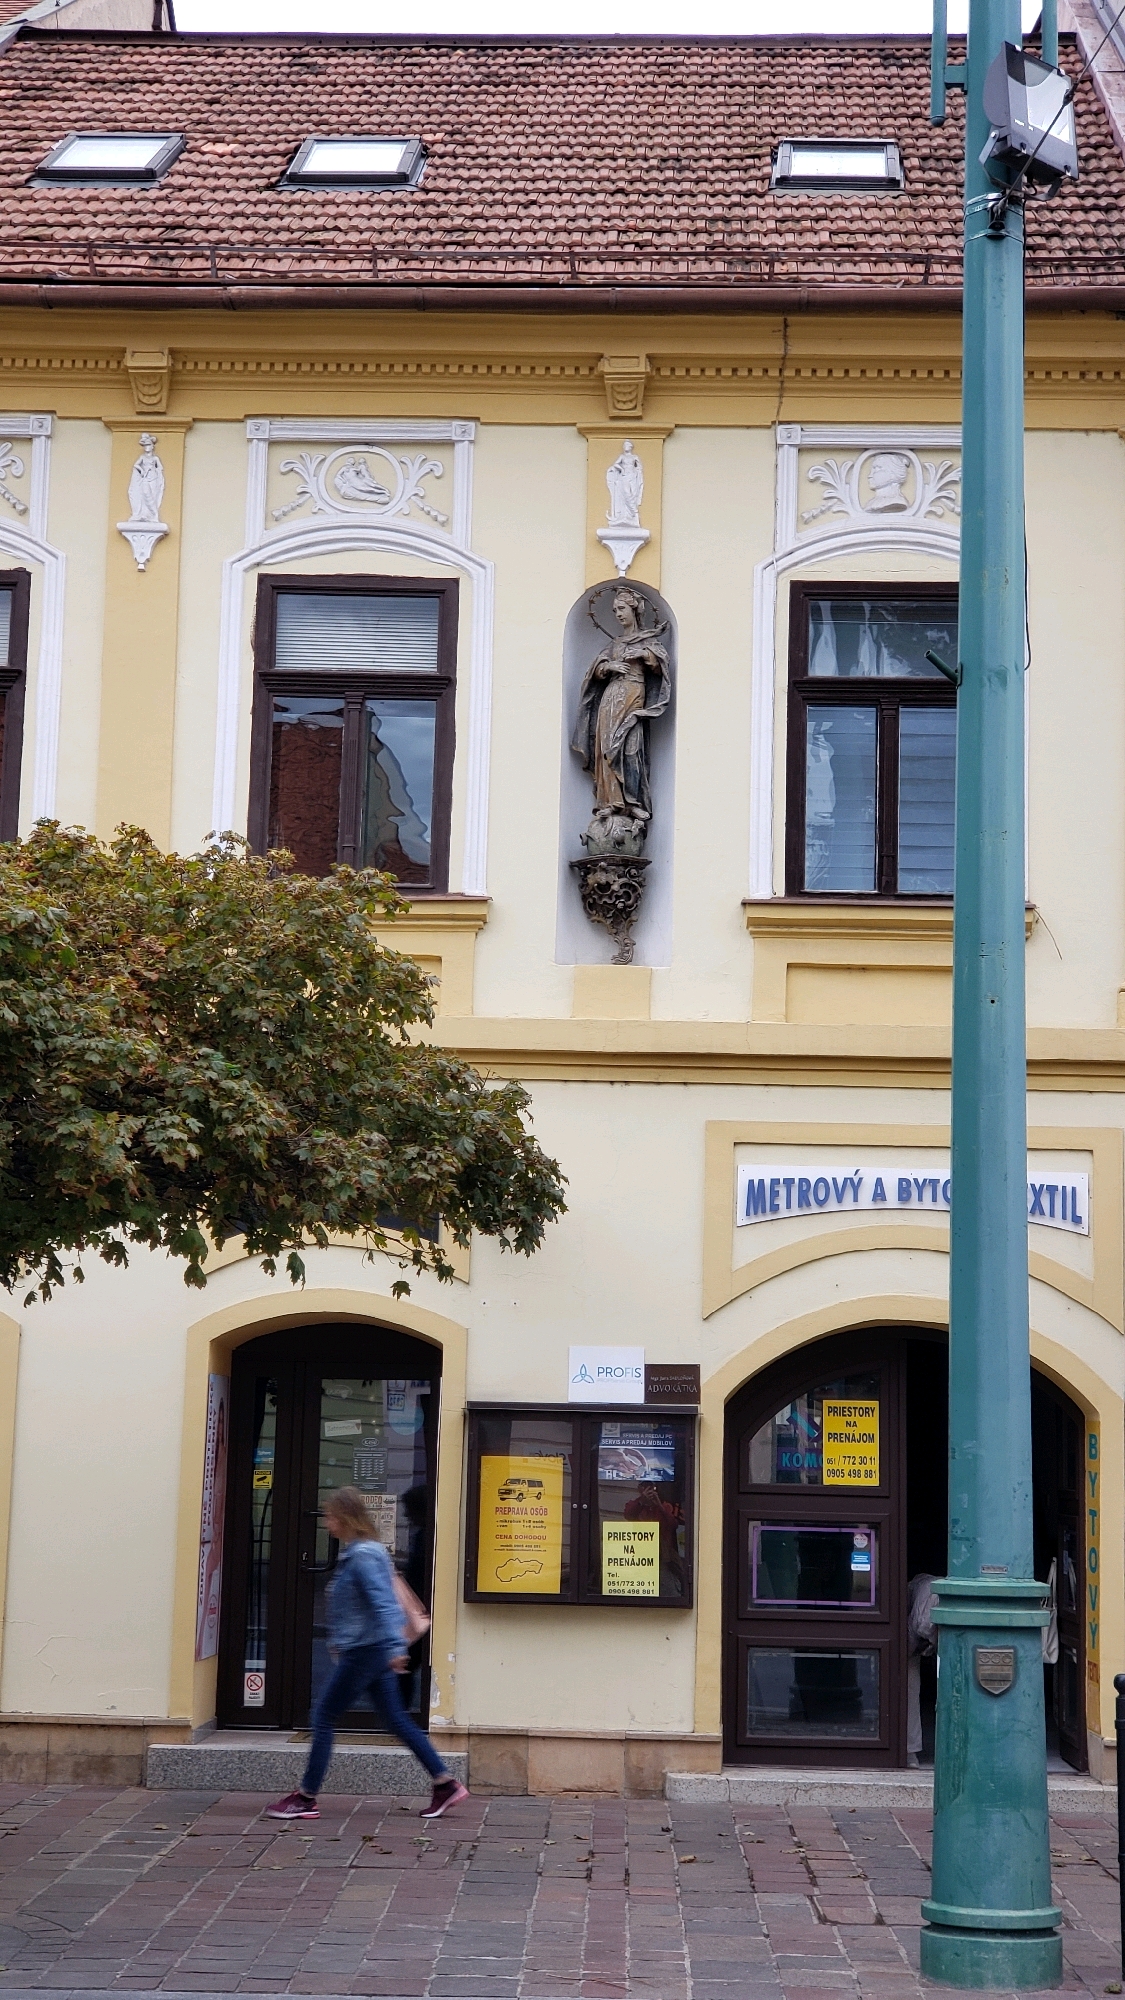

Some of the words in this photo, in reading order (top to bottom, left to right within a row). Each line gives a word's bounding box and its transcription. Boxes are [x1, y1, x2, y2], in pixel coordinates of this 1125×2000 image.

[745, 1169, 863, 1217] METROVÝ
[872, 1177, 887, 1202] A
[1027, 1183, 1083, 1225] XTIL
[597, 1366, 642, 1378] PROFIS
[647, 1381, 698, 1393] ADVOKÁTKA
[827, 1406, 876, 1418] PRIESTORY
[827, 1430, 875, 1444] PRENÁJOM
[826, 1457, 836, 1465] 051
[842, 1456, 857, 1466] 772
[858, 1456, 868, 1466] 30
[869, 1456, 876, 1466] 11
[826, 1468, 845, 1479] 0905
[847, 1468, 862, 1479] 498
[863, 1469, 877, 1479] 881
[495, 1506, 528, 1516] PREPRAVA
[607, 1531, 655, 1541] PRIESTORY
[1088, 1433, 1098, 1650] BYTOVÝ
[623, 1545, 635, 1554] NA
[607, 1555, 654, 1567] PRENÁJOM
